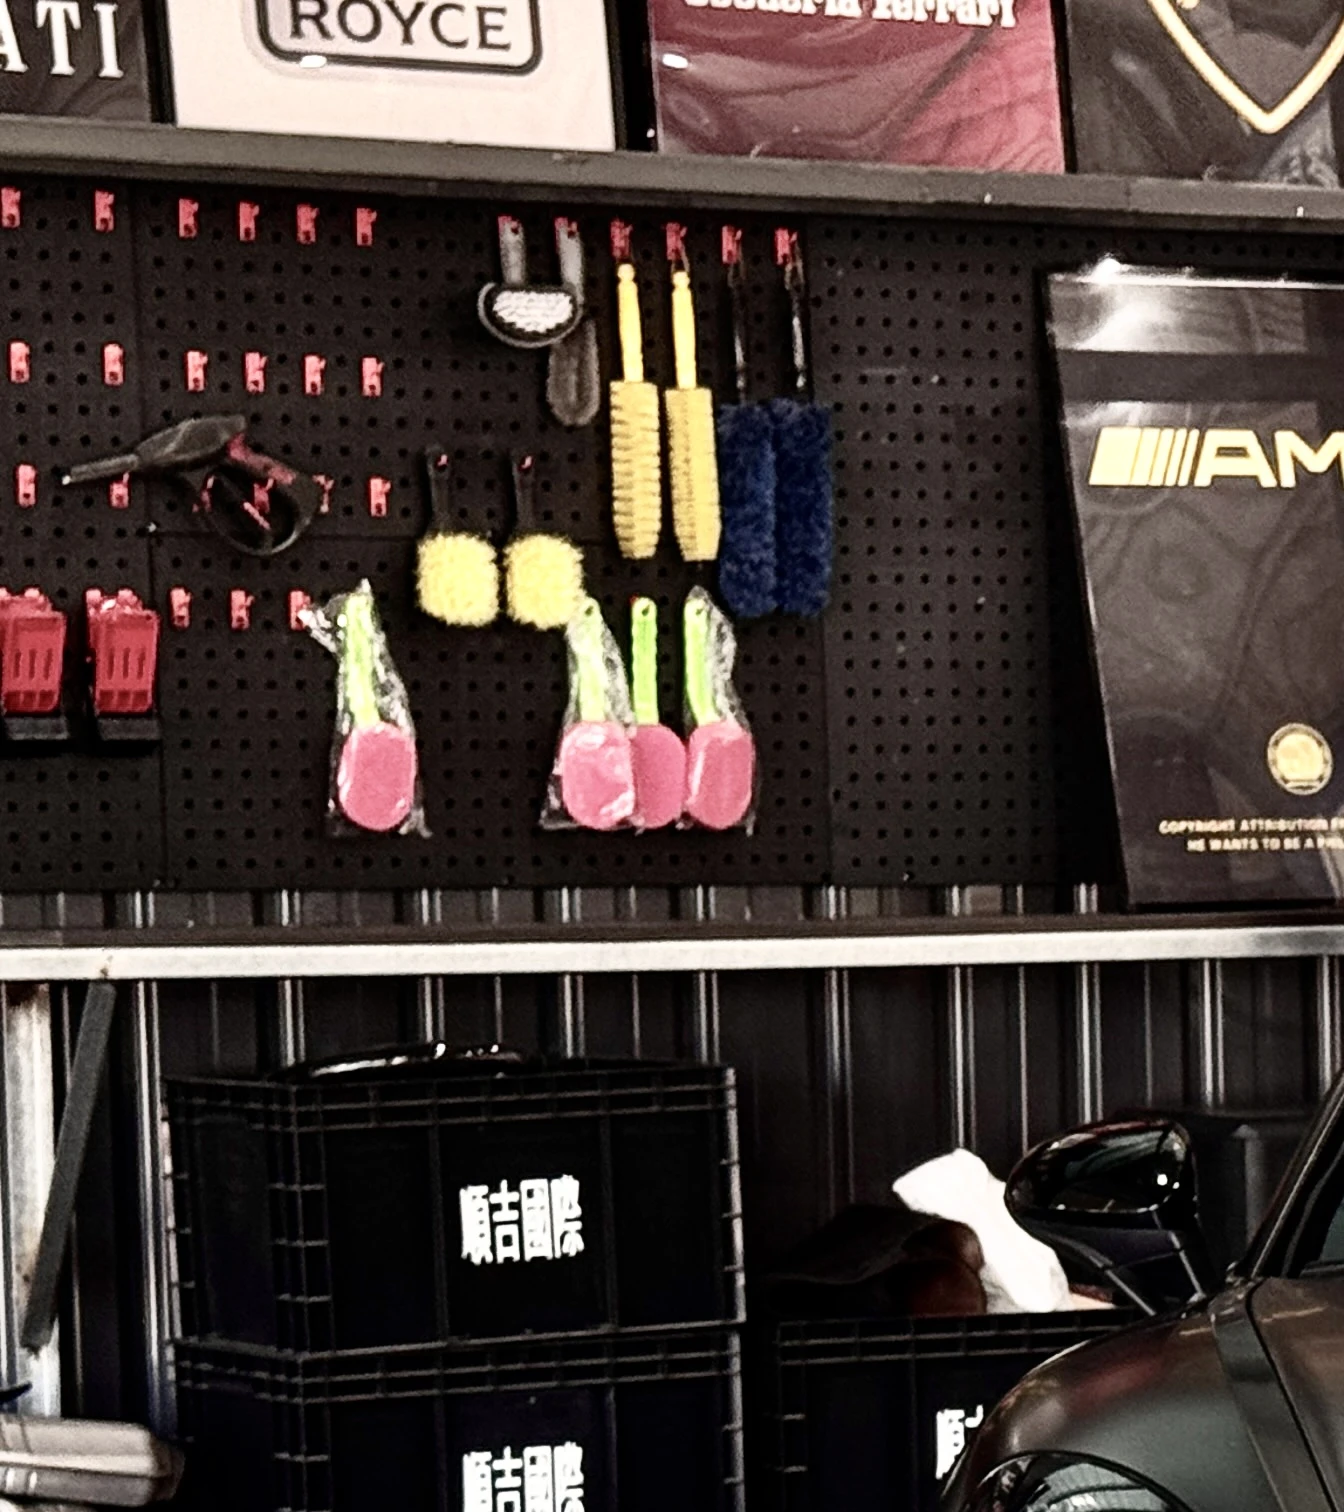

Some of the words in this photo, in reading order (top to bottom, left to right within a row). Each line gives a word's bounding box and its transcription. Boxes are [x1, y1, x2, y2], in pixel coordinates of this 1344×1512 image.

[289, 0, 511, 51] ROYCE
[1158, 818, 1236, 834] COPYRIGHT
[1209, 837, 1259, 851] WANTS
[1262, 837, 1281, 850] TO
[1304, 837, 1315, 849] A
[459, 1174, 585, 1265] 順吉國際
[936, 1405, 984, 1480] 順
